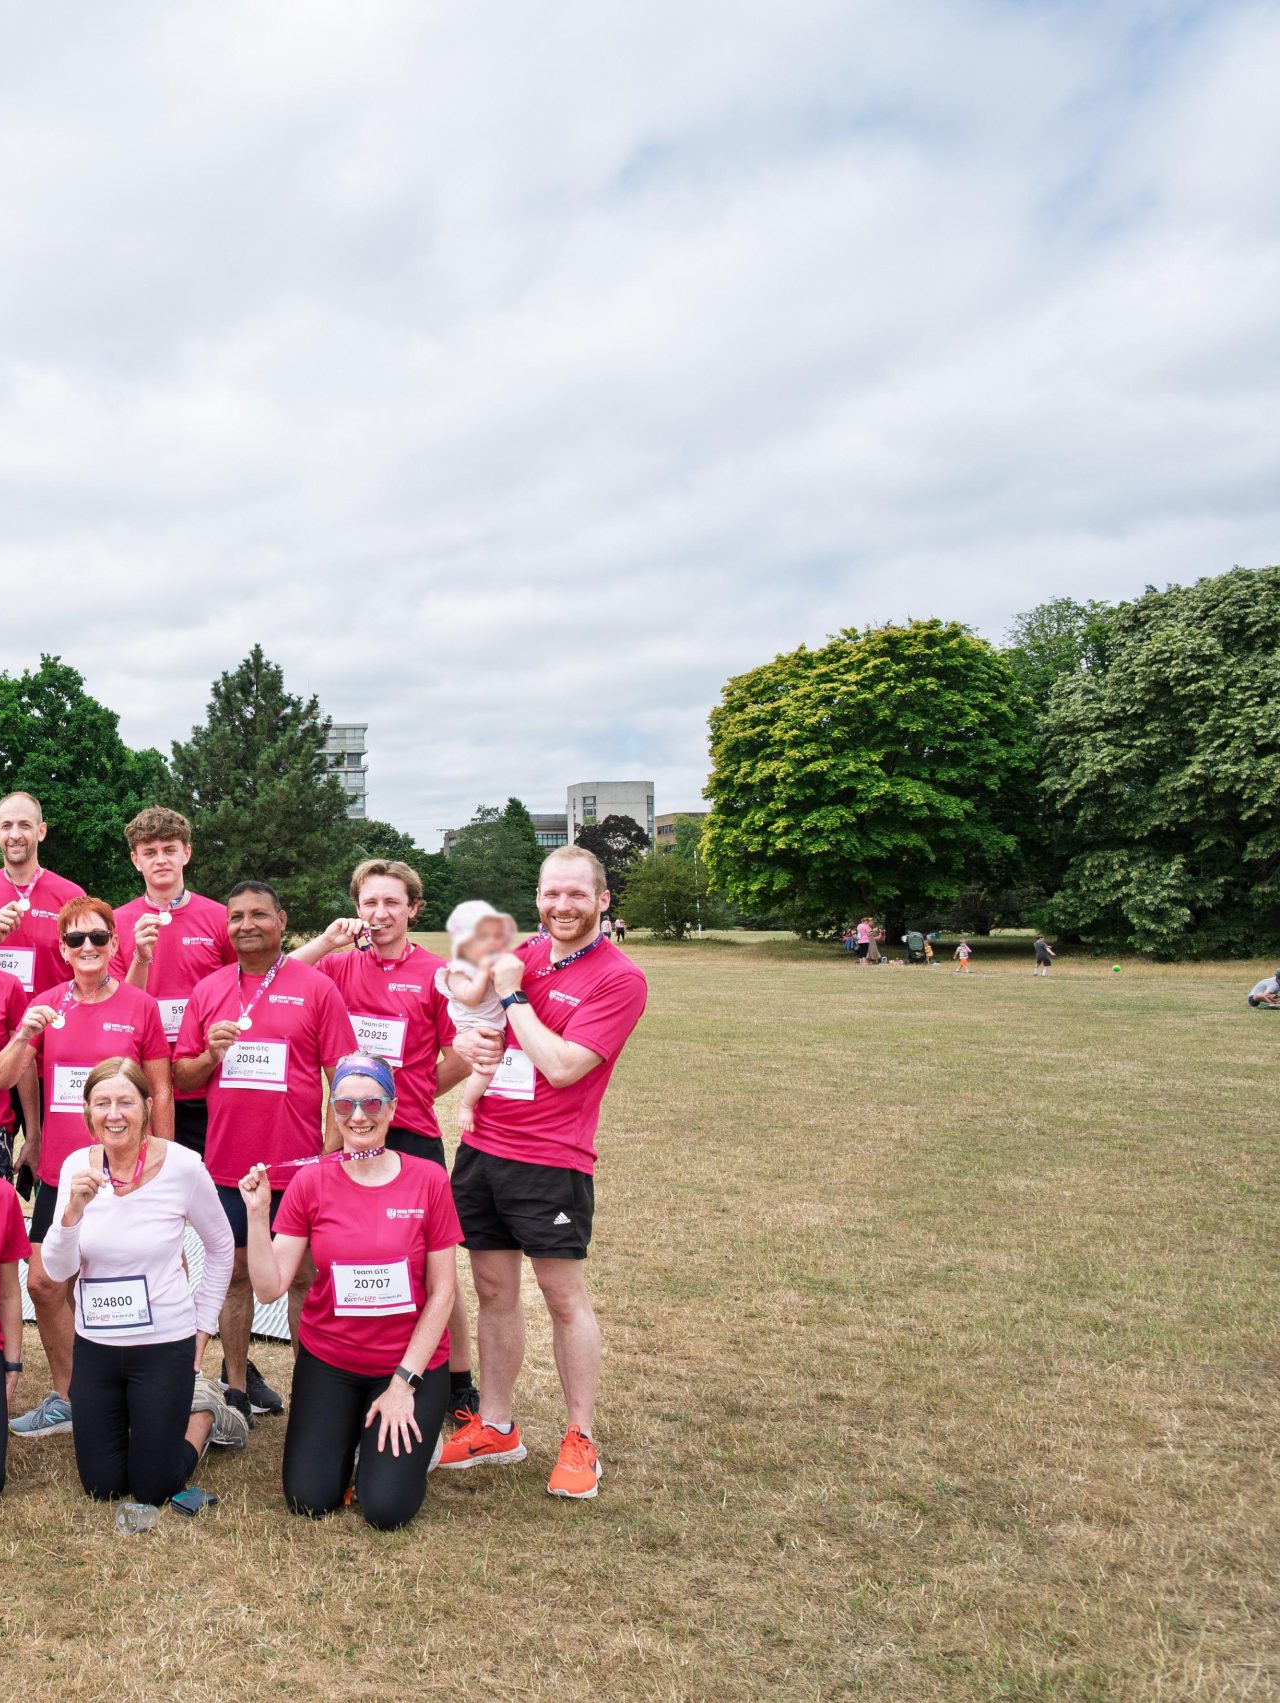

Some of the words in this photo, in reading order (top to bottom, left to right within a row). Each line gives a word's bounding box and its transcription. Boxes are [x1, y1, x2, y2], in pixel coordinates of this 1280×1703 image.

[171, 1005, 185, 1015] 59
[361, 1019, 378, 1027] Team
[357, 1028, 388, 1041] 20925
[236, 1053, 270, 1064] 20844
[70, 1079, 87, 1088] 20
[354, 1278, 391, 1289] 20707
[91, 1295, 133, 1308] 324800
